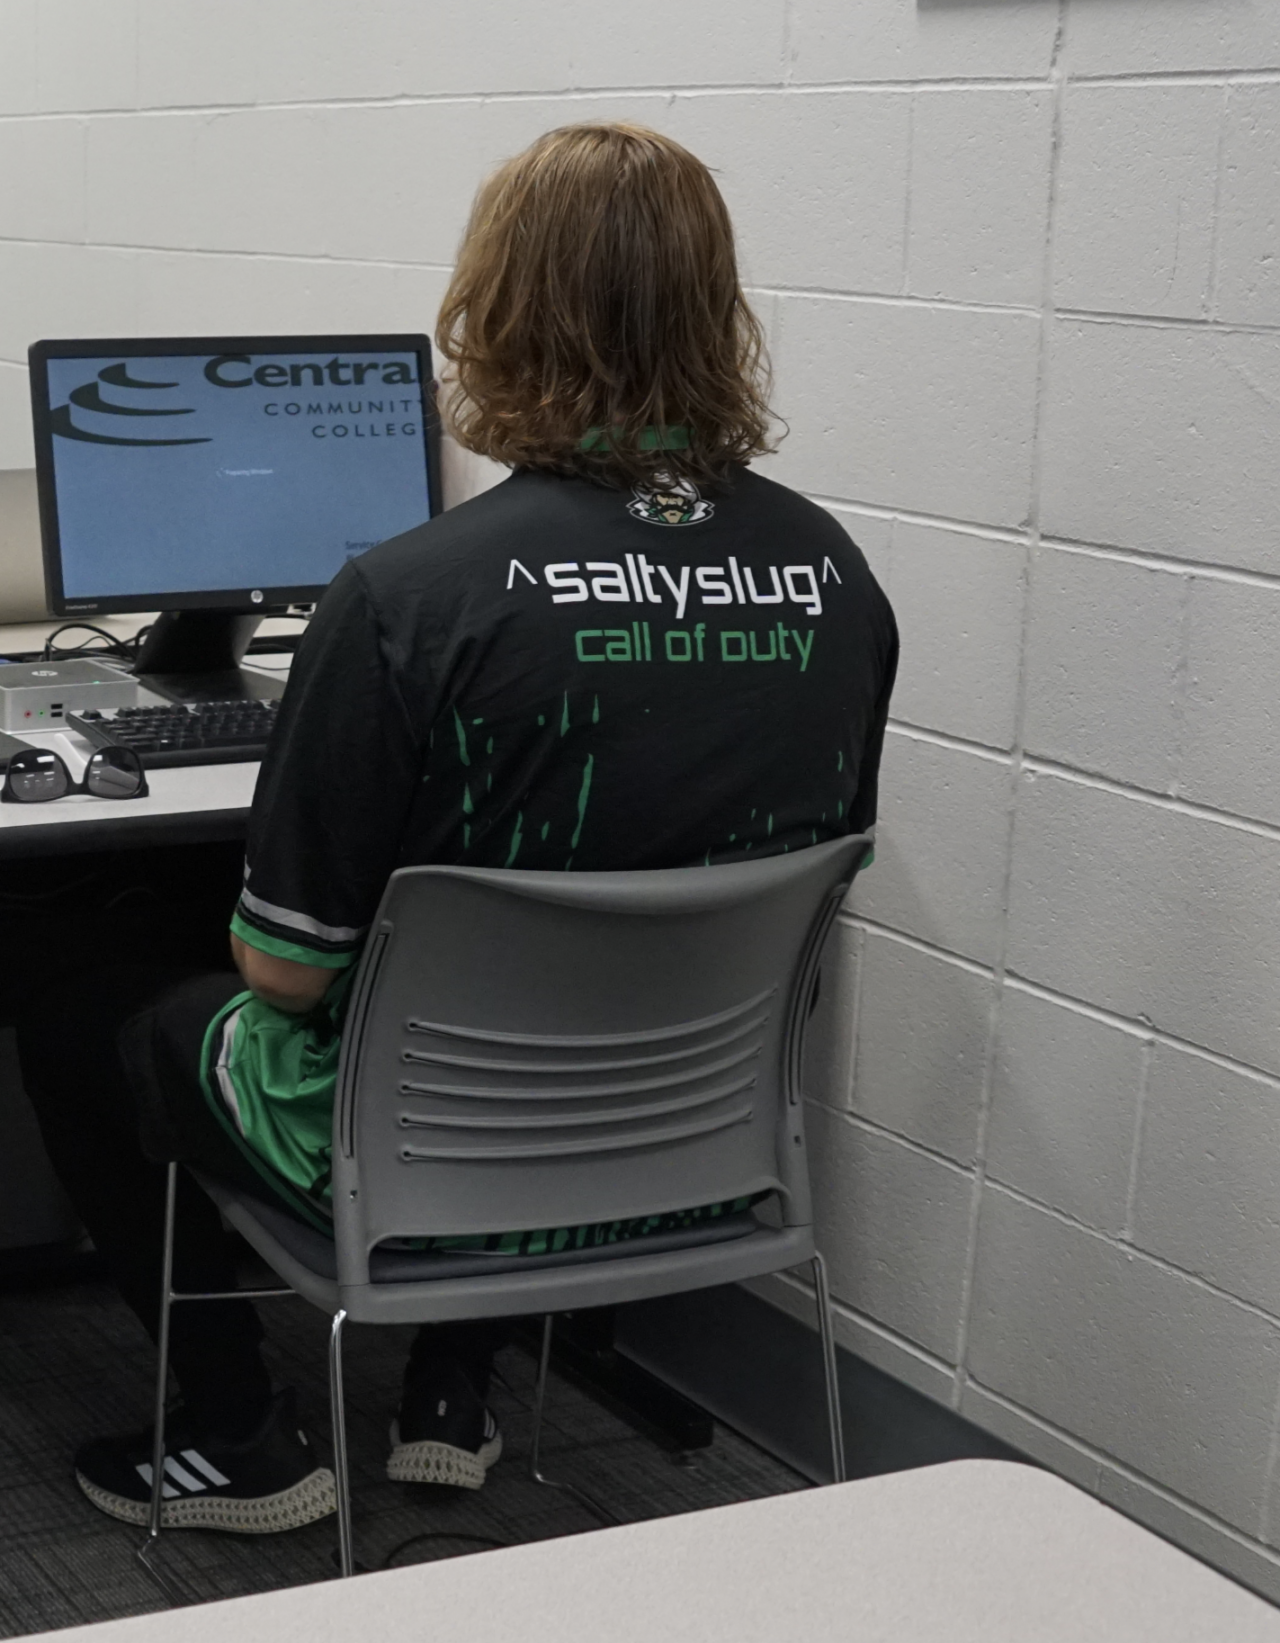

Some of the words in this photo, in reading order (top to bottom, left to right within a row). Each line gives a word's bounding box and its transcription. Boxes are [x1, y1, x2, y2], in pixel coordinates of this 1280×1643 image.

[264, 399, 421, 416] COMMUNIT
[575, 621, 651, 662] call
[665, 623, 705, 662] of
